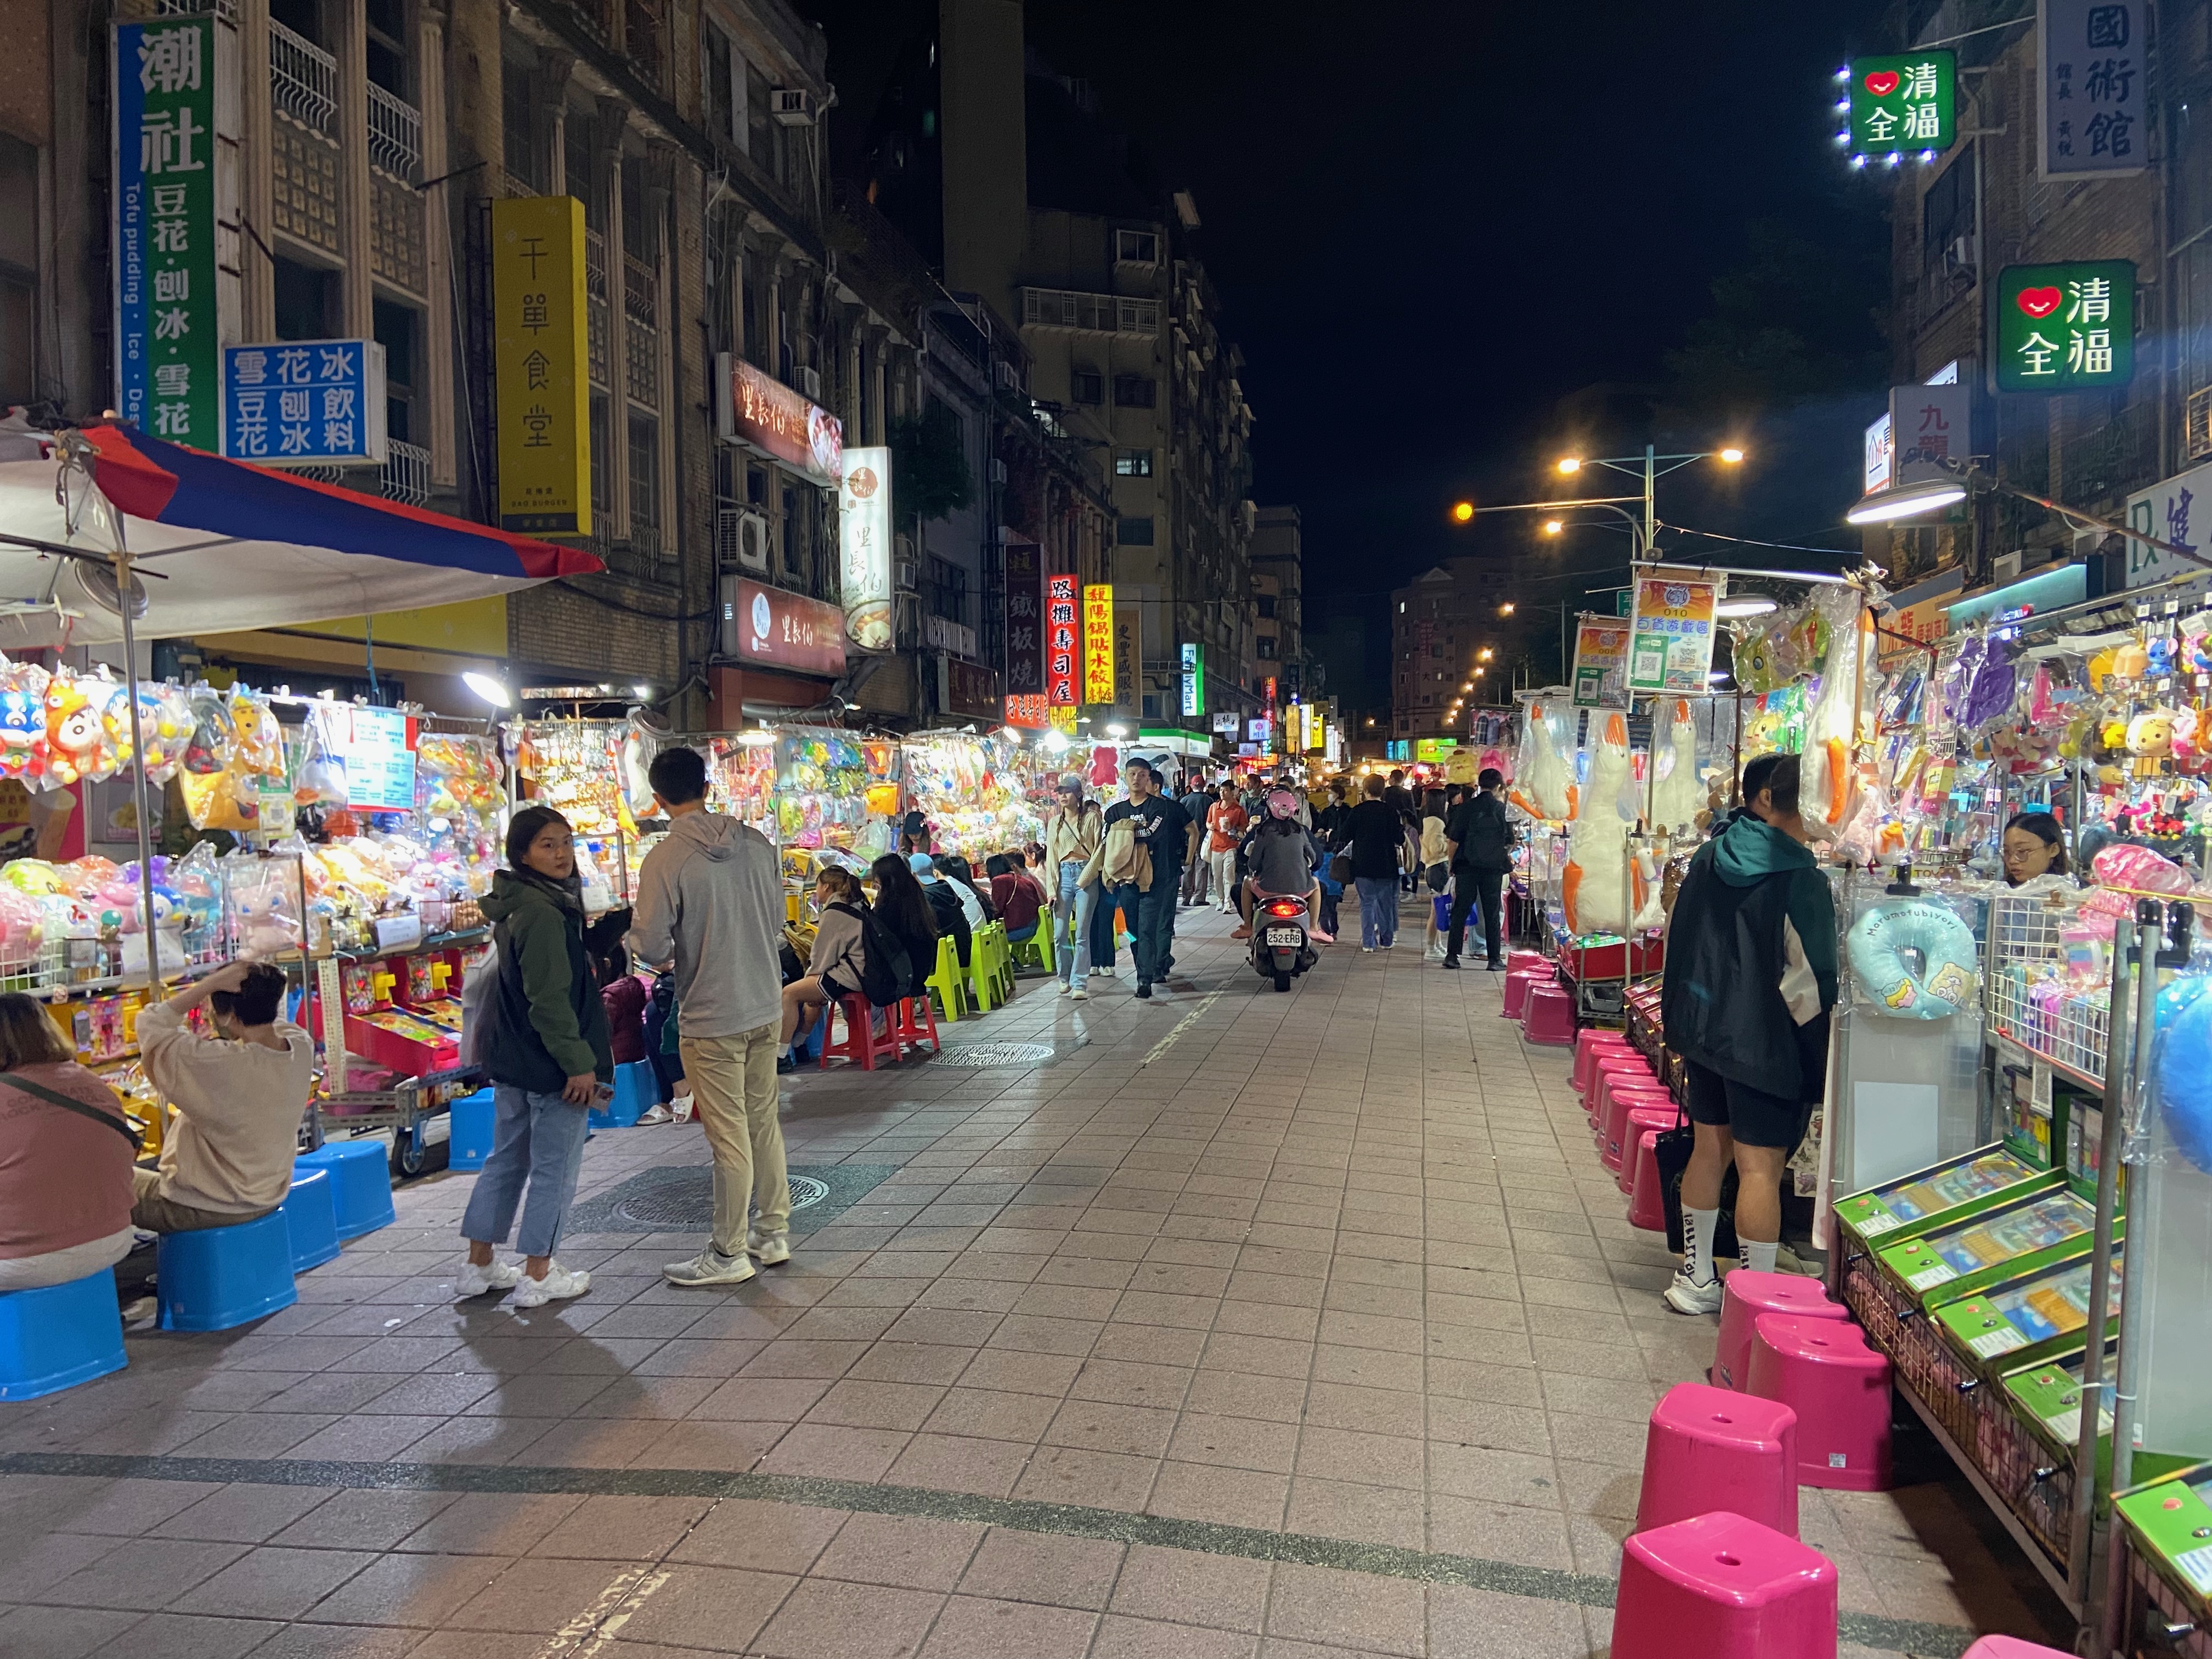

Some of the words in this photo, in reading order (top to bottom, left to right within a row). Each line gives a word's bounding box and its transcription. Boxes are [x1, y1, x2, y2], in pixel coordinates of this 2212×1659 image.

[138, 26, 205, 173] 潮社
[2085, 4, 2135, 159] 國術館
[126, 182, 140, 223] Tofu
[123, 228, 142, 304] pudding
[128, 333, 142, 359] Ice
[234, 347, 354, 385] 雪花冰
[236, 390, 268, 456] 豆花
[279, 389, 311, 454] 刨冰
[323, 388, 354, 453] 飲料
[742, 385, 785, 435] 里長伯
[532, 499, 567, 507] BURGER
[847, 526, 882, 594] 里長伯
[782, 615, 814, 646] 里長伯
[1052, 580, 1074, 702] 路攤壽司屋
[1637, 617, 1709, 634] 百貨遊戲區
[1664, 608, 1688, 617] 010
